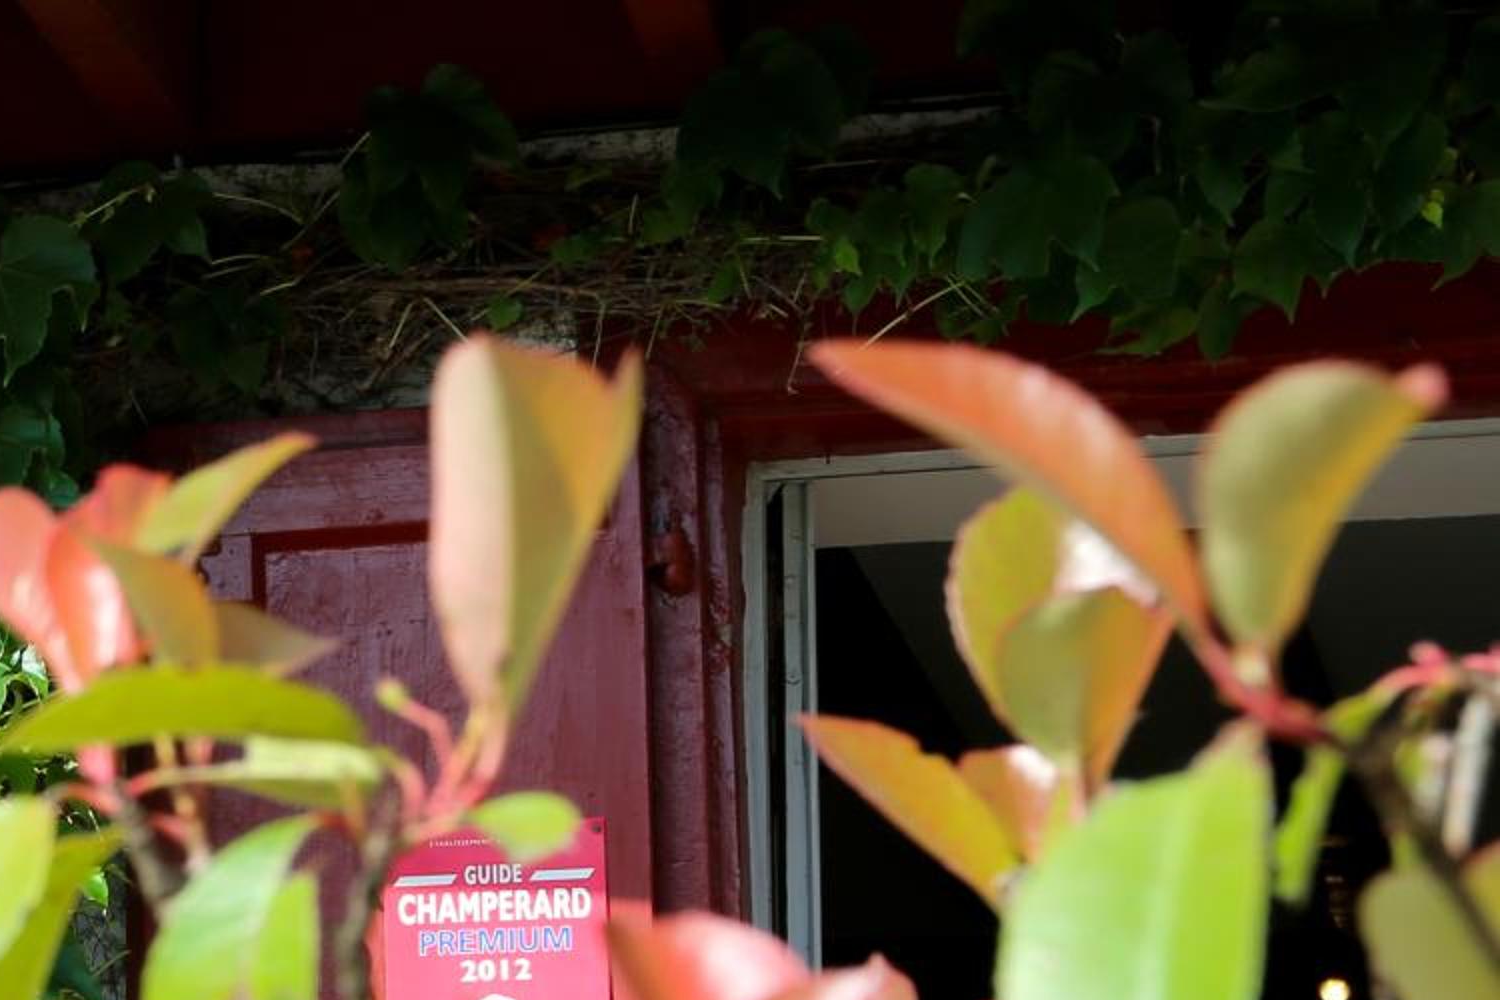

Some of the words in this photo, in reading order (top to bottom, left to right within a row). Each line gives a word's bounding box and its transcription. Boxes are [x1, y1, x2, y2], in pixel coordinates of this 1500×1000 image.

[464, 862, 523, 885] GUIDE
[397, 887, 592, 925] CHAMPERARD
[419, 926, 573, 956] PREMIUM
[460, 958, 532, 983] 2012
